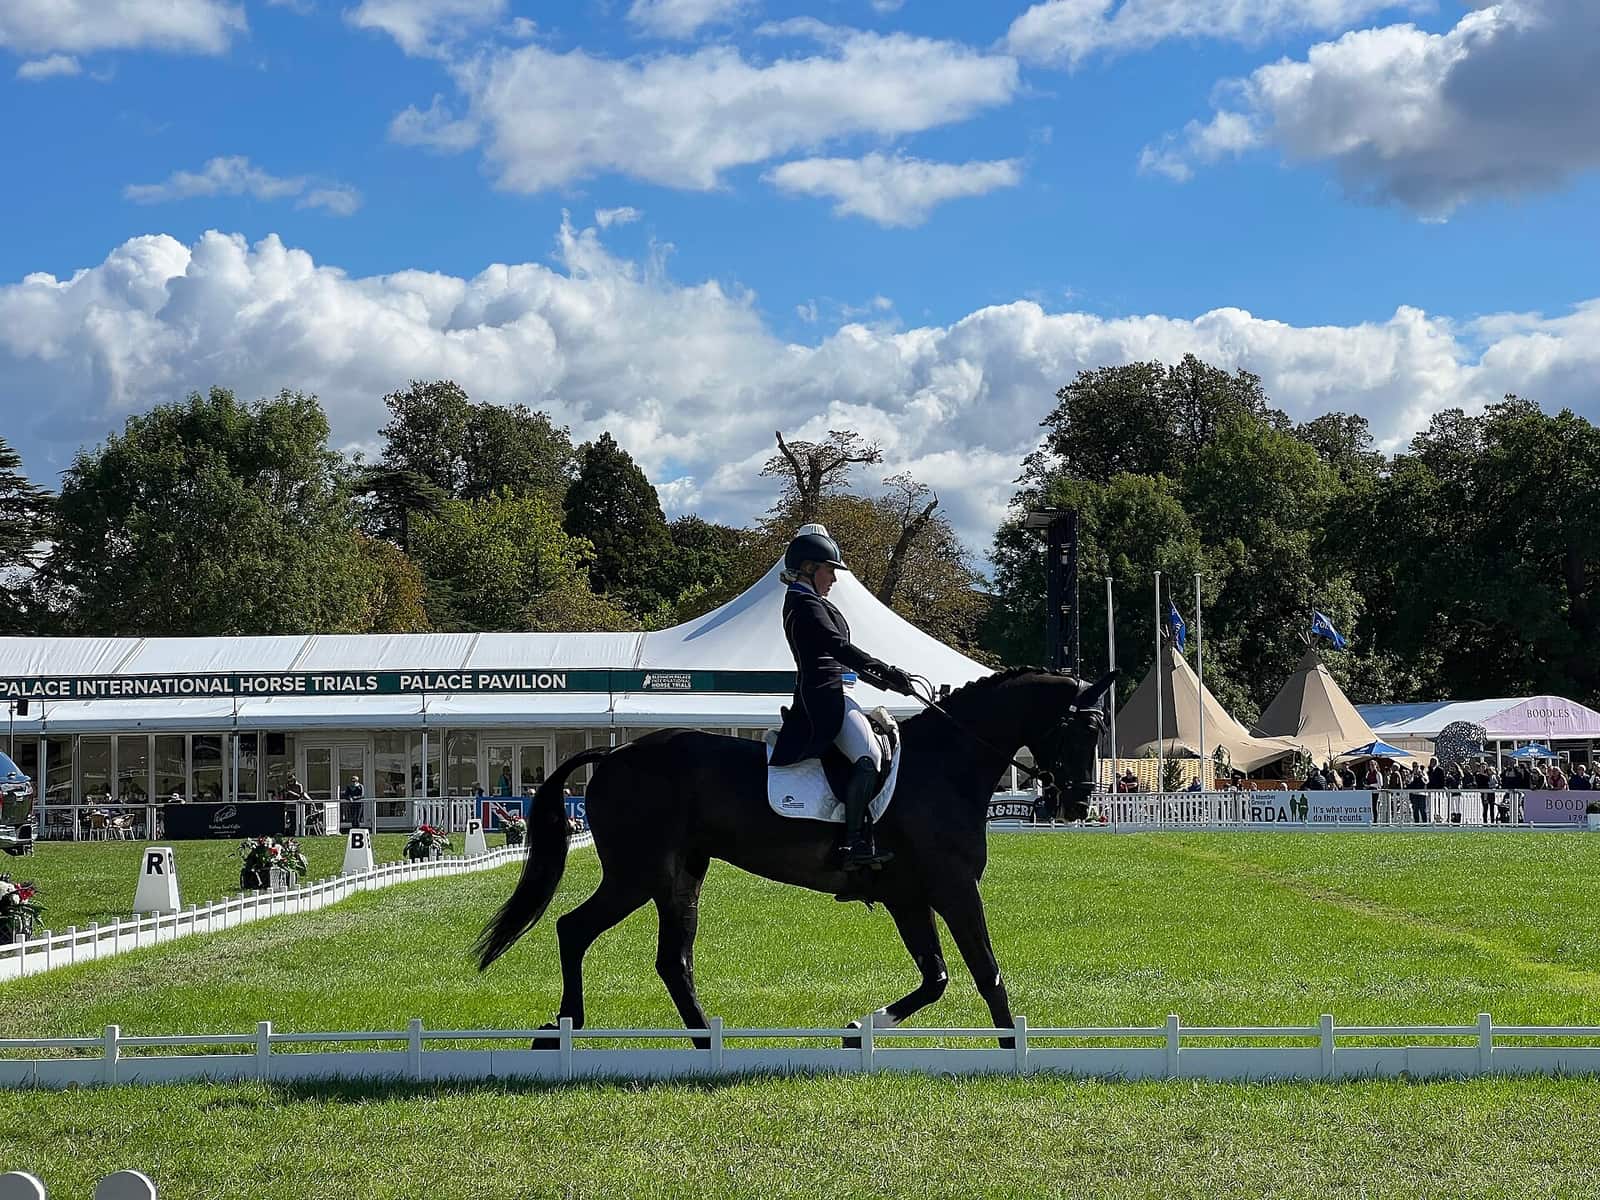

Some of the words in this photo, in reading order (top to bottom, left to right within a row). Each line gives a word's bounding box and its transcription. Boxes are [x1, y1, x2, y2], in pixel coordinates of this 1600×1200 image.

[76, 678, 233, 695] INTERNATIONAL
[239, 677, 306, 692] HORSE
[311, 676, 378, 691] TRIALS
[399, 675, 473, 690] PALACE
[478, 673, 567, 689] PAVILION
[1526, 708, 1570, 718] BOODLES
[1251, 806, 1288, 822] RDA
[1313, 805, 1324, 813] It's
[1325, 805, 1343, 813] what
[1339, 813, 1362, 821] counts
[469, 822, 480, 835] P
[351, 832, 364, 848] B
[146, 853, 164, 875] R
